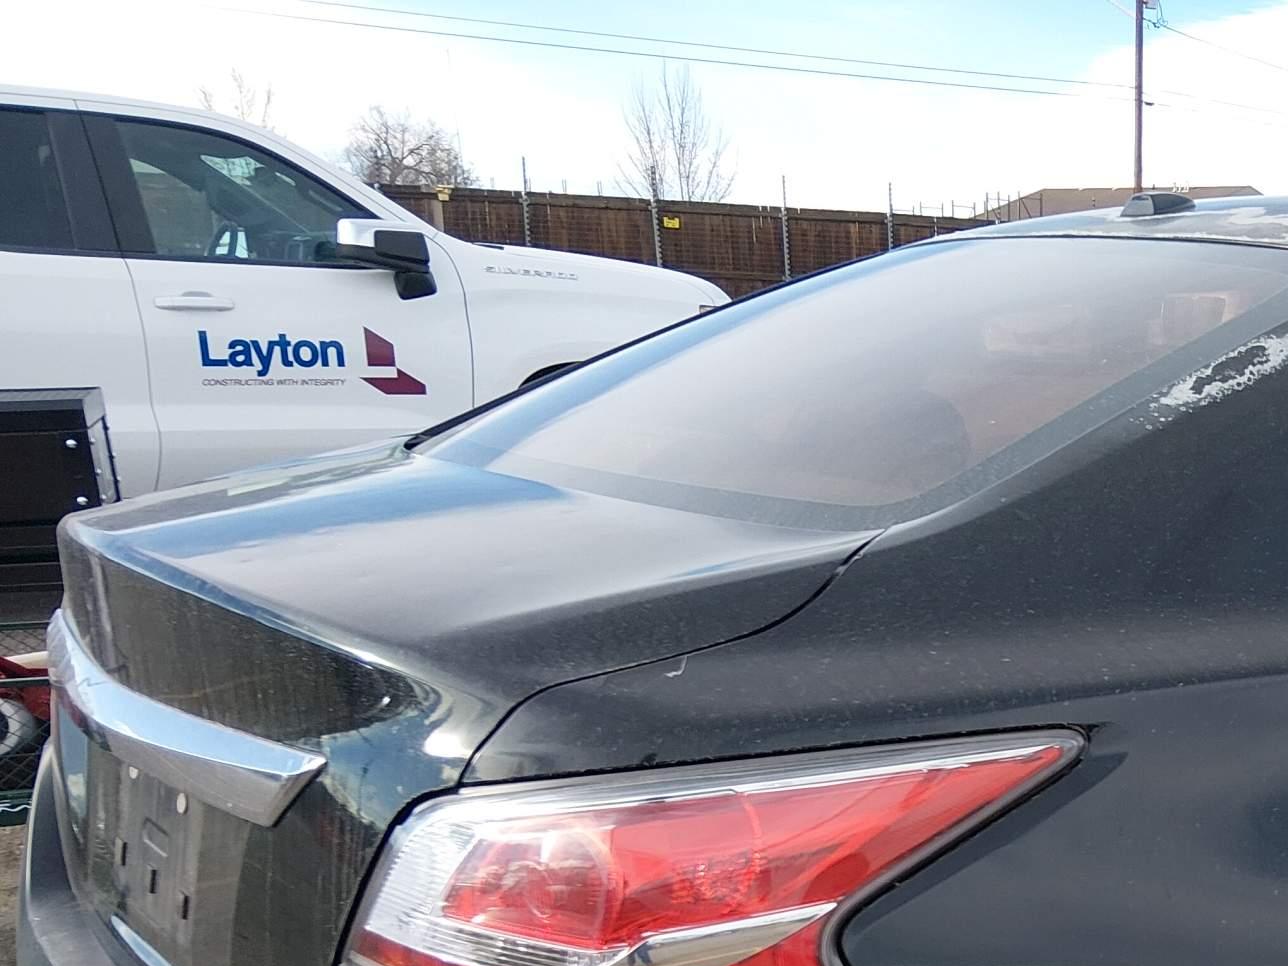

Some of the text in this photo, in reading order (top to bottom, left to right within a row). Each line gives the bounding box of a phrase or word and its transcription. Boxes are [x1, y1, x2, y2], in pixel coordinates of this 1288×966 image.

[484, 265, 579, 281] SILVERADO
[197, 330, 346, 377] Layton
[201, 378, 346, 387] CONSTRUCTING WITH INTEGRITY
